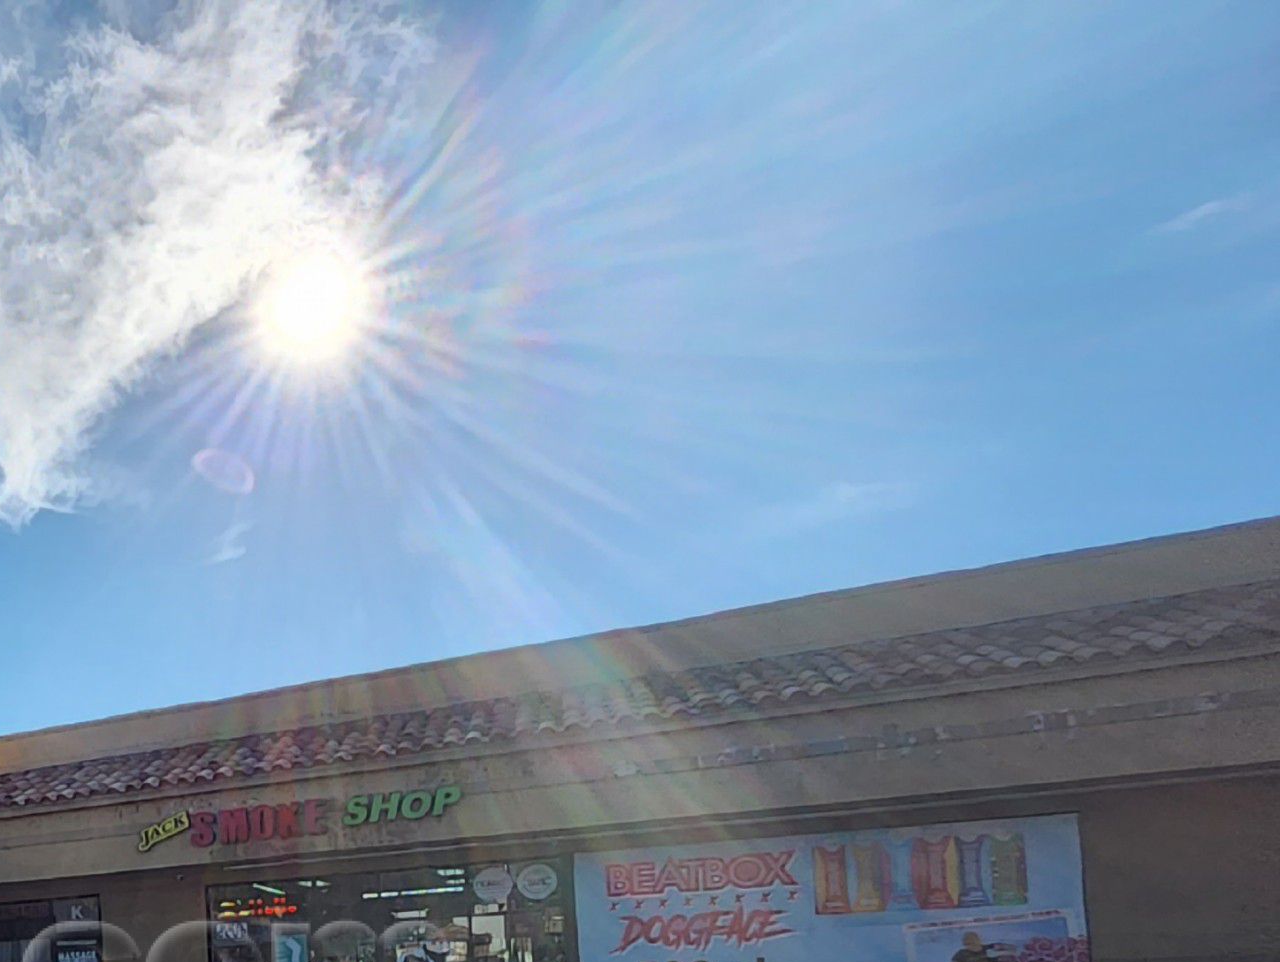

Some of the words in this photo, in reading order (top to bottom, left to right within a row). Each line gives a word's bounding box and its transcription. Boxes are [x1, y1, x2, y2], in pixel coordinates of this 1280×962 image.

[140, 813, 188, 850] JACK
[190, 799, 329, 848] SMOKE
[342, 785, 463, 827] SHOP
[606, 850, 797, 896] BEATBOX
[608, 905, 797, 954] DOGGFACE
